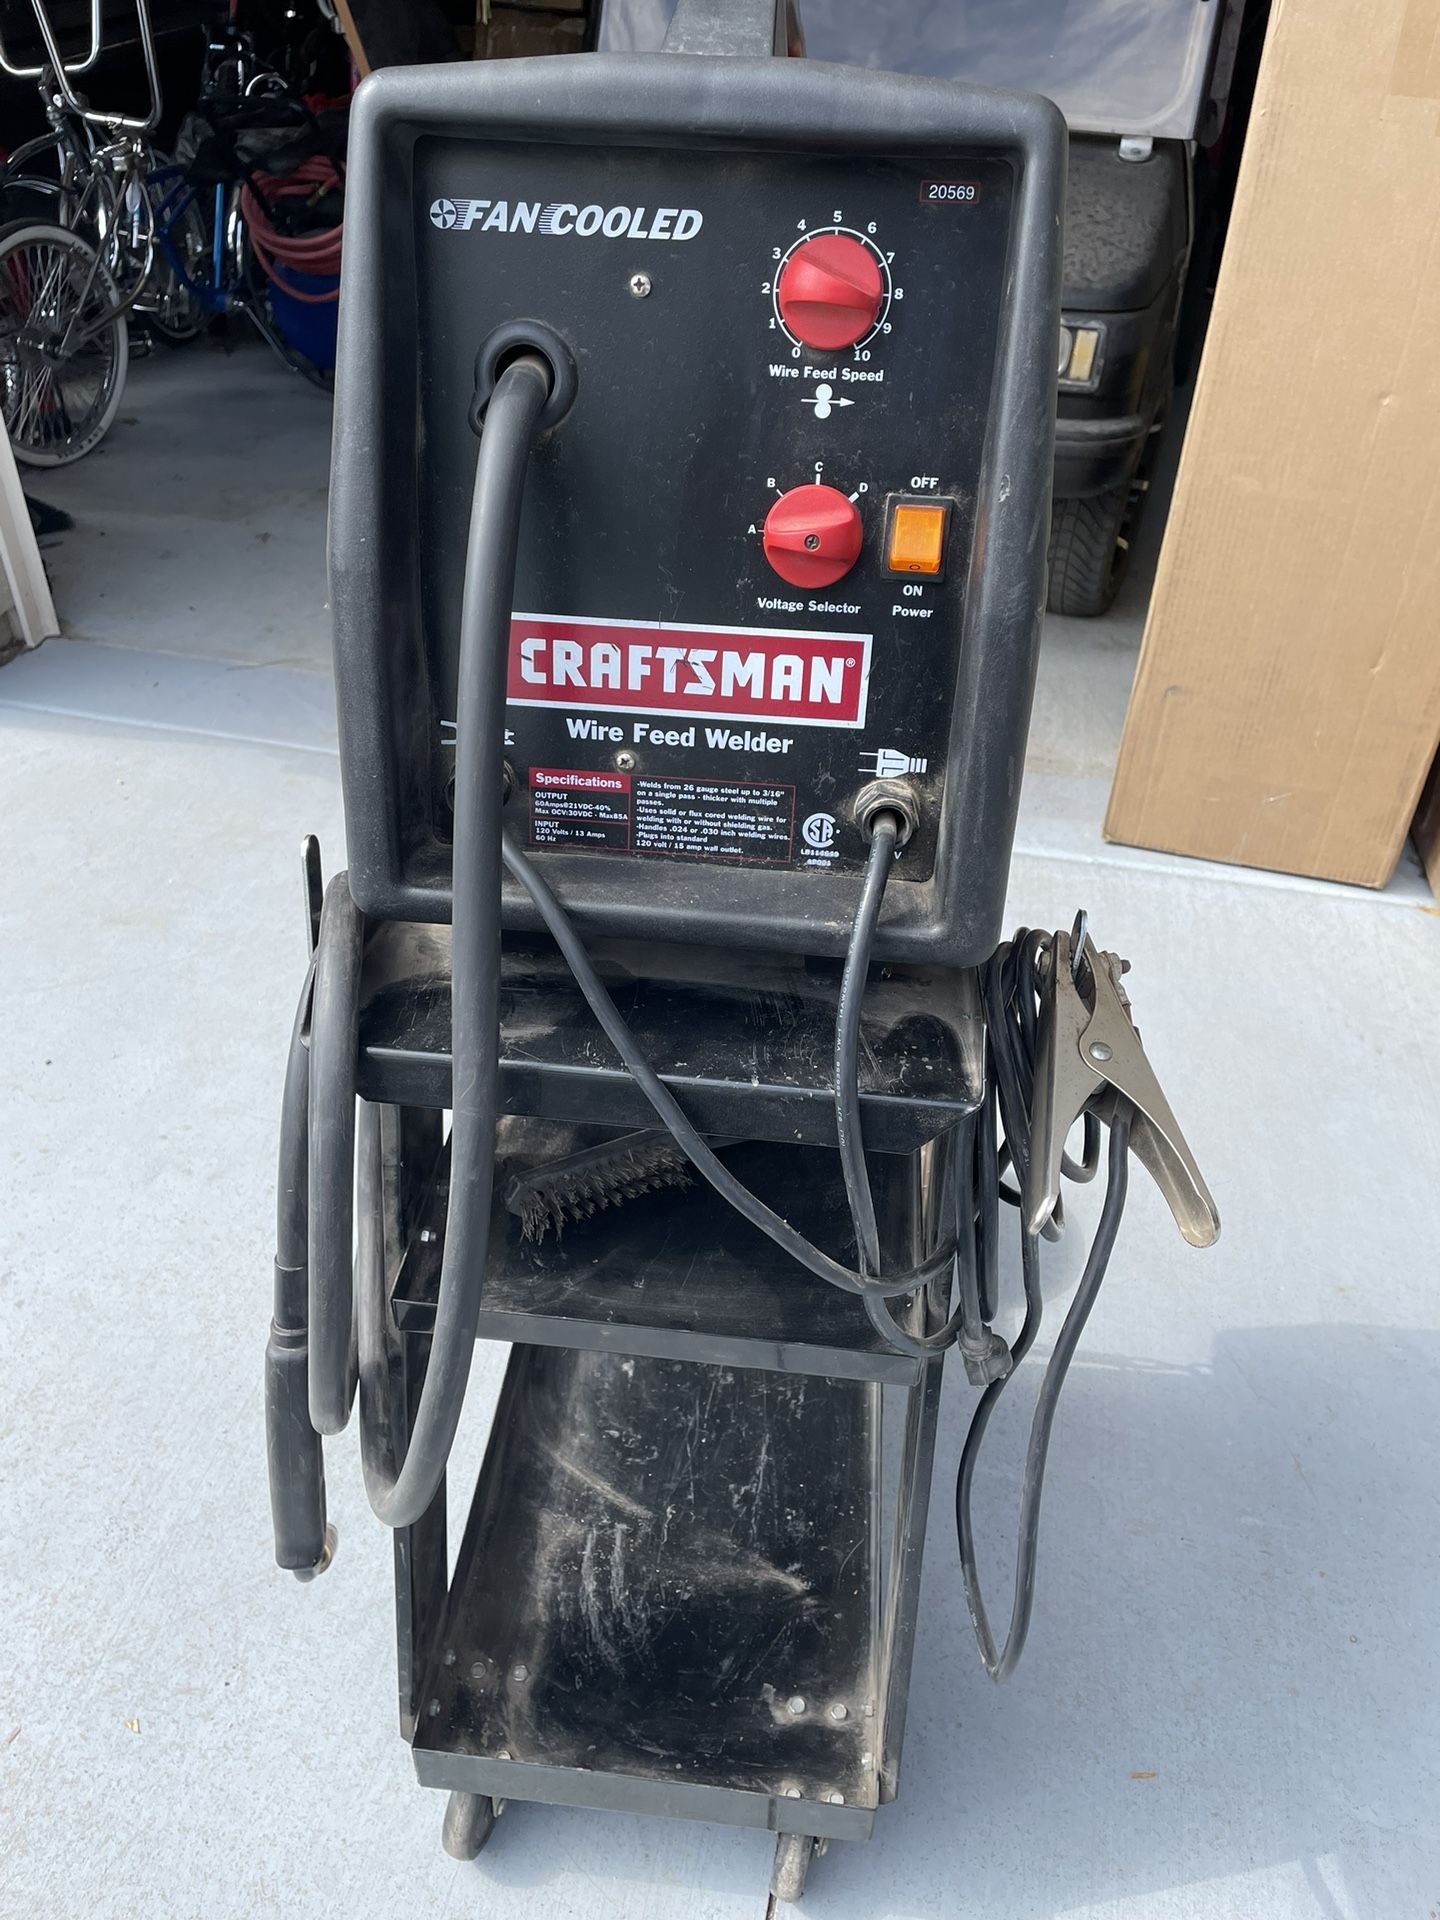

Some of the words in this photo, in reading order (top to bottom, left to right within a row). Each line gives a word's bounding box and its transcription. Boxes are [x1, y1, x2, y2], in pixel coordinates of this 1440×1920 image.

[928, 184, 975, 200] 20569
[456, 199, 542, 234] FAN
[544, 203, 703, 241] COOLED
[833, 210, 842, 223] 5
[796, 219, 807, 231] 4
[867, 222, 877, 234] 6
[772, 247, 781, 260] 3
[886, 252, 896, 264] 7
[761, 282, 771, 294] 2
[894, 288, 904, 300] 8
[768, 317, 776, 329] 1
[882, 322, 892, 334] 9
[791, 346, 801, 358] 0
[853, 350, 871, 362] 10
[769, 364, 800, 378] Wire
[803, 366, 837, 380] Feed
[841, 367, 884, 382] Speed
[814, 461, 824, 472] C
[767, 477, 776, 488] B
[859, 482, 869, 493] D
[910, 476, 940, 489] OFF
[747, 524, 757, 534] A
[902, 584, 923, 597] ON
[757, 597, 804, 612] Voltage
[808, 599, 862, 614] Selector
[892, 605, 934, 618] Power
[566, 718, 624, 742] Wire
[633, 723, 695, 748] Feed
[705, 728, 793, 754] Welder
[535, 772, 623, 789] Specifications
[664, 782, 681, 790] from
[696, 786, 719, 794] gauge
[535, 791, 568, 800] OUTPUT
[654, 790, 677, 799] single
[678, 792, 696, 800] pass
[702, 794, 729, 802] thicker
[730, 796, 746, 804] with
[748, 798, 778, 806] multiple
[534, 820, 560, 828] INPUT
[636, 815, 665, 824] welding
[693, 819, 721, 827] without
[723, 822, 756, 830] shielding
[727, 813, 756, 822] welding
[757, 815, 774, 823] wire
[776, 816, 787, 824] for
[552, 828, 569, 836] Volts
[586, 831, 606, 839] Amps
[669, 825, 688, 833] .024
[738, 831, 766, 840] welding
[676, 834, 708, 843] standard
[720, 846, 744, 854] outlet.
